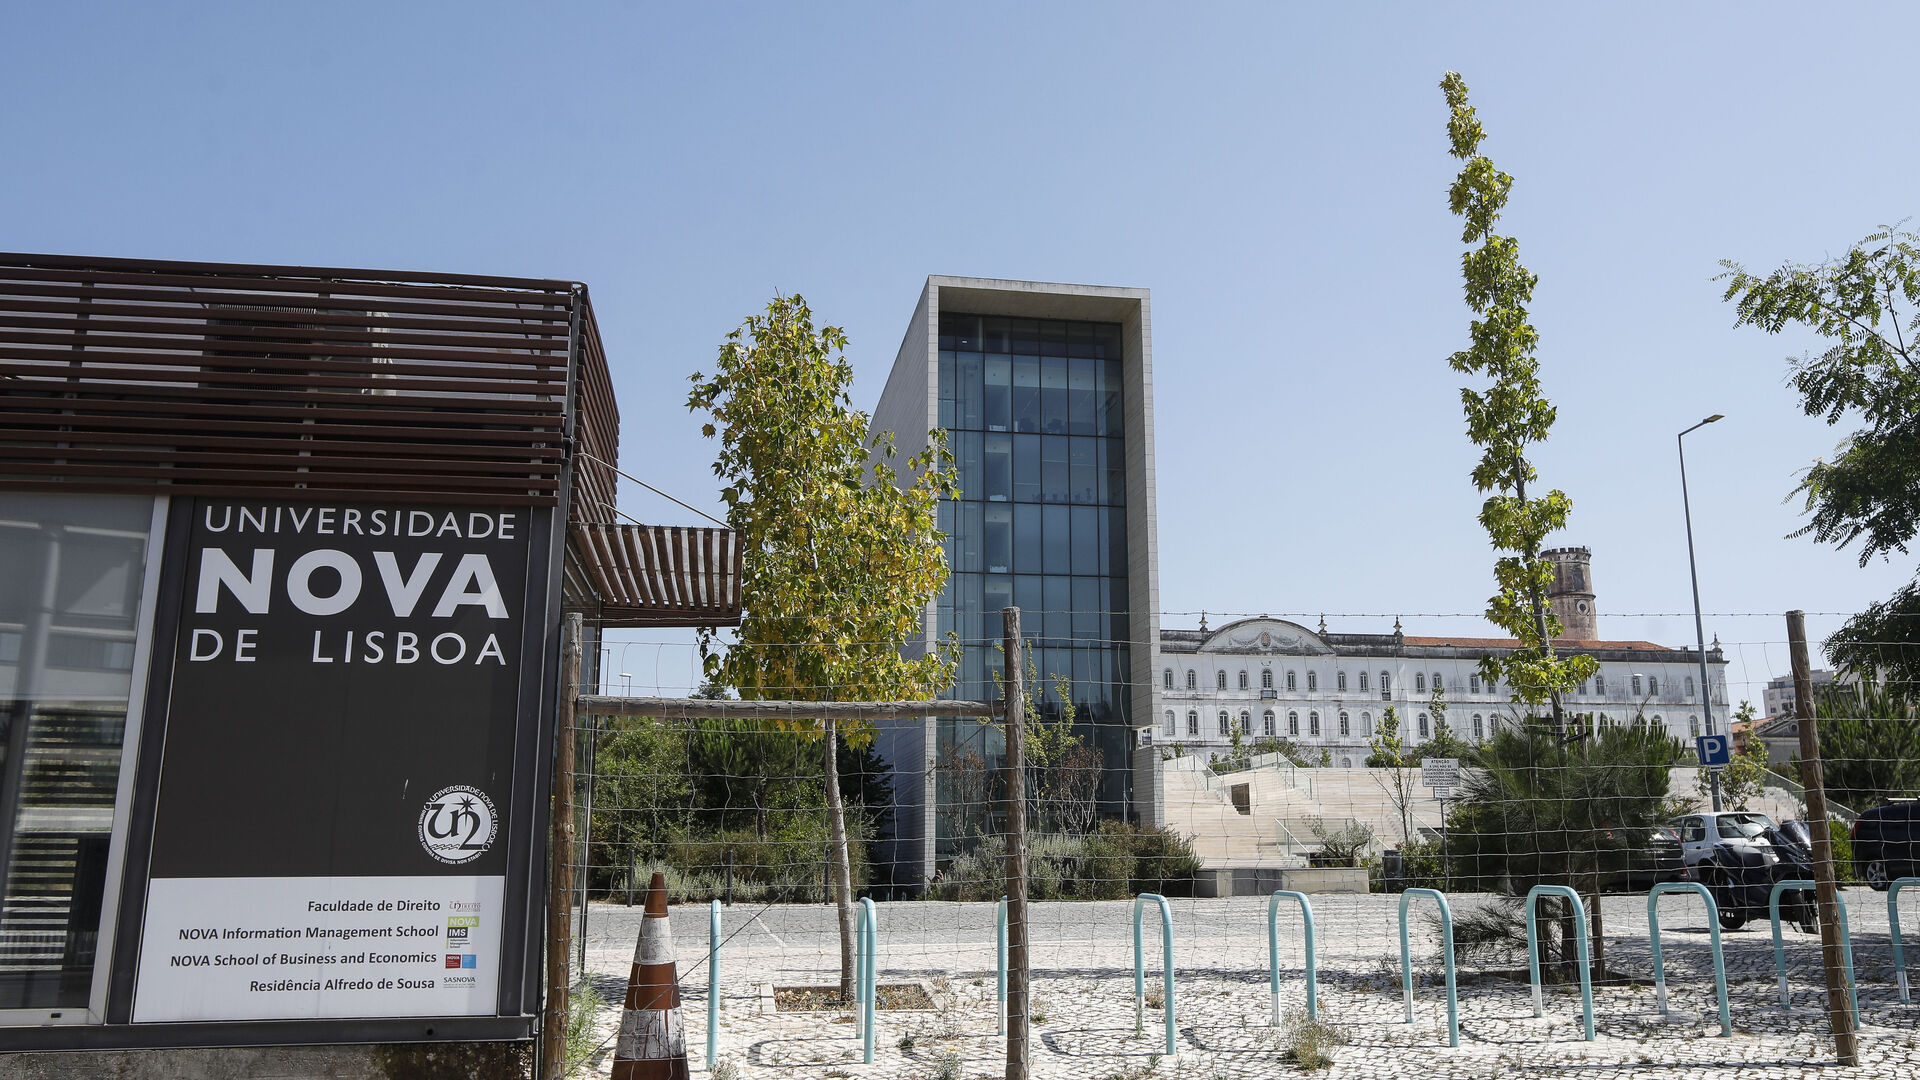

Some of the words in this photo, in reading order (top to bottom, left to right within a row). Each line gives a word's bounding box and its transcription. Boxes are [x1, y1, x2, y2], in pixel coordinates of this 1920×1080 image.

[205, 506, 516, 539] UNIVERSIDADE
[195, 547, 509, 619] NOVA
[190, 628, 258, 662] DE
[312, 630, 507, 665] LISBOA
[1703, 739, 1721, 762] P
[430, 785, 480, 802] UNIVERSIDADE
[479, 792, 494, 809] NOVA
[490, 809, 497, 819] DE
[489, 820, 498, 845] LISBOA
[308, 900, 373, 912] Faculdade
[377, 900, 393, 911] de
[397, 900, 440, 911] Direito
[449, 918, 477, 926] NOVA
[178, 928, 218, 940] NOVA
[222, 927, 301, 939] Information
[305, 927, 393, 940] Management
[396, 925, 439, 937] School
[448, 928, 466, 937] IMS
[170, 955, 210, 967] NOVA
[214, 954, 259, 966] School
[262, 953, 277, 965] of
[280, 953, 337, 965] Business
[340, 952, 365, 964] and
[369, 952, 437, 964] Economics
[250, 979, 321, 992] Residência
[324, 978, 373, 990] Alfredo
[377, 978, 393, 990] de
[397, 978, 435, 989] Sousa
